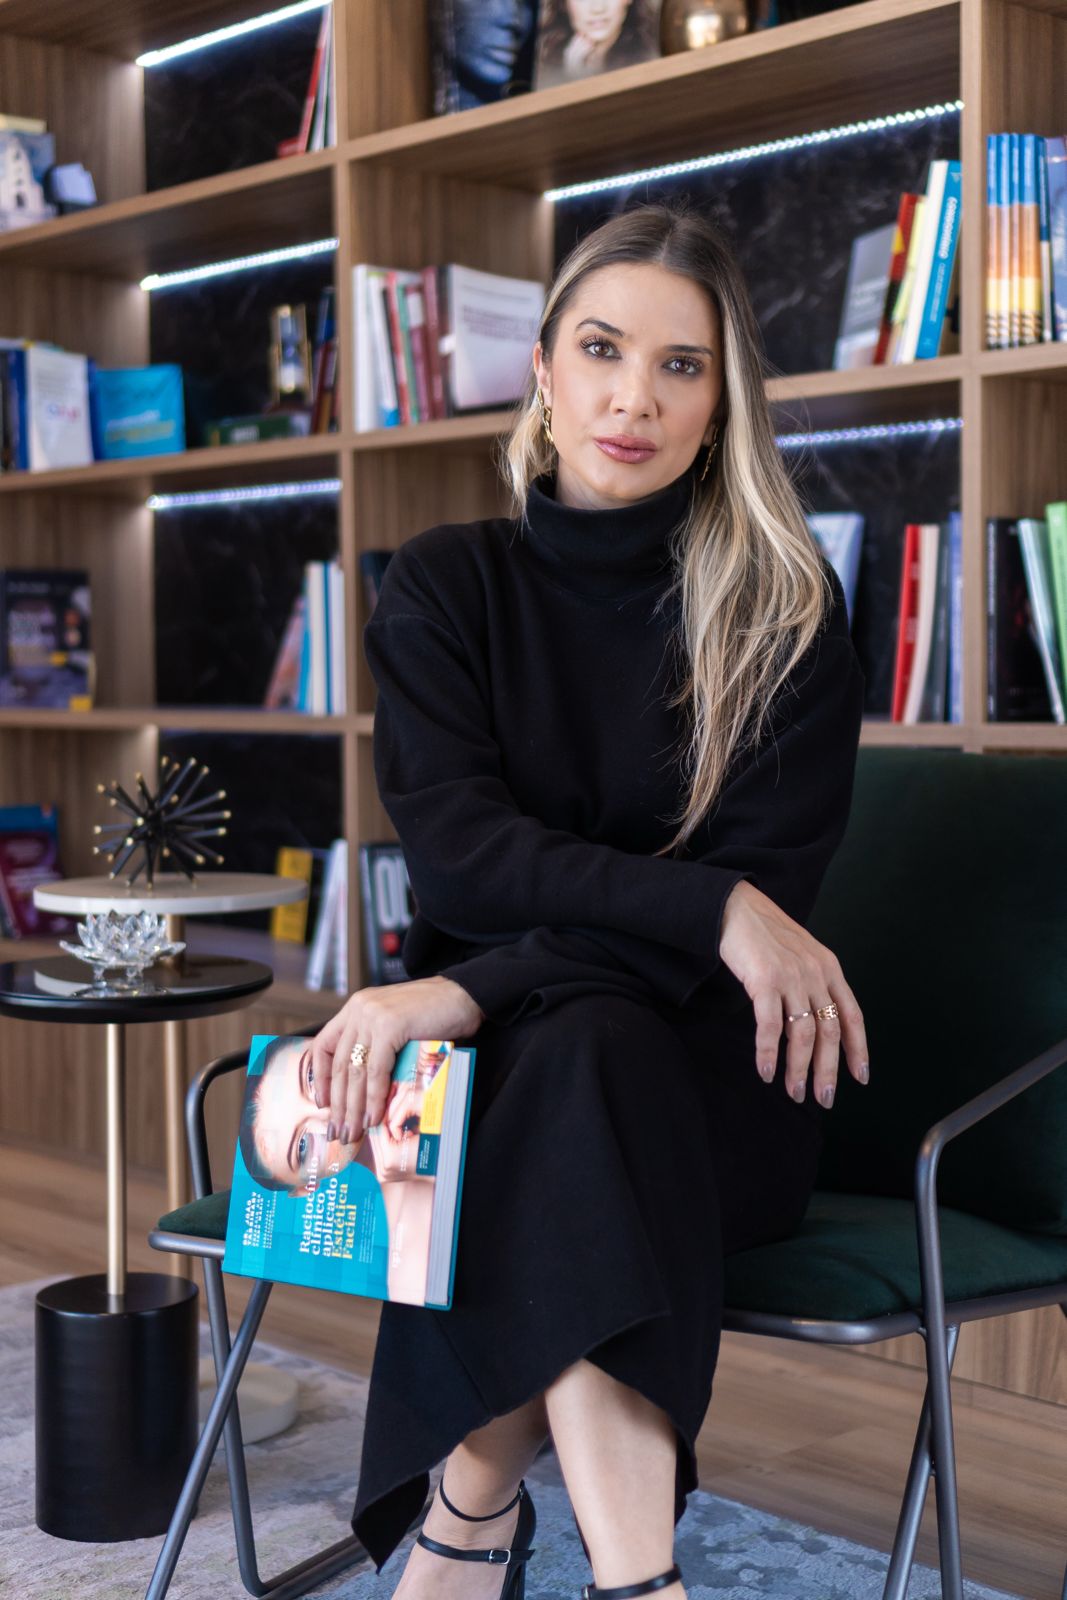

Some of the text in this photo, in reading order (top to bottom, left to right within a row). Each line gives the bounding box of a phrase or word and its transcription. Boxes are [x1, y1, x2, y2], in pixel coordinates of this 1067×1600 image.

[299, 1156, 319, 1253] Raciocínio
[311, 1192, 326, 1256] clínico
[322, 1162, 340, 1258] aplicado à
[331, 1183, 349, 1258] Estética
[342, 1204, 357, 1259] Facial
